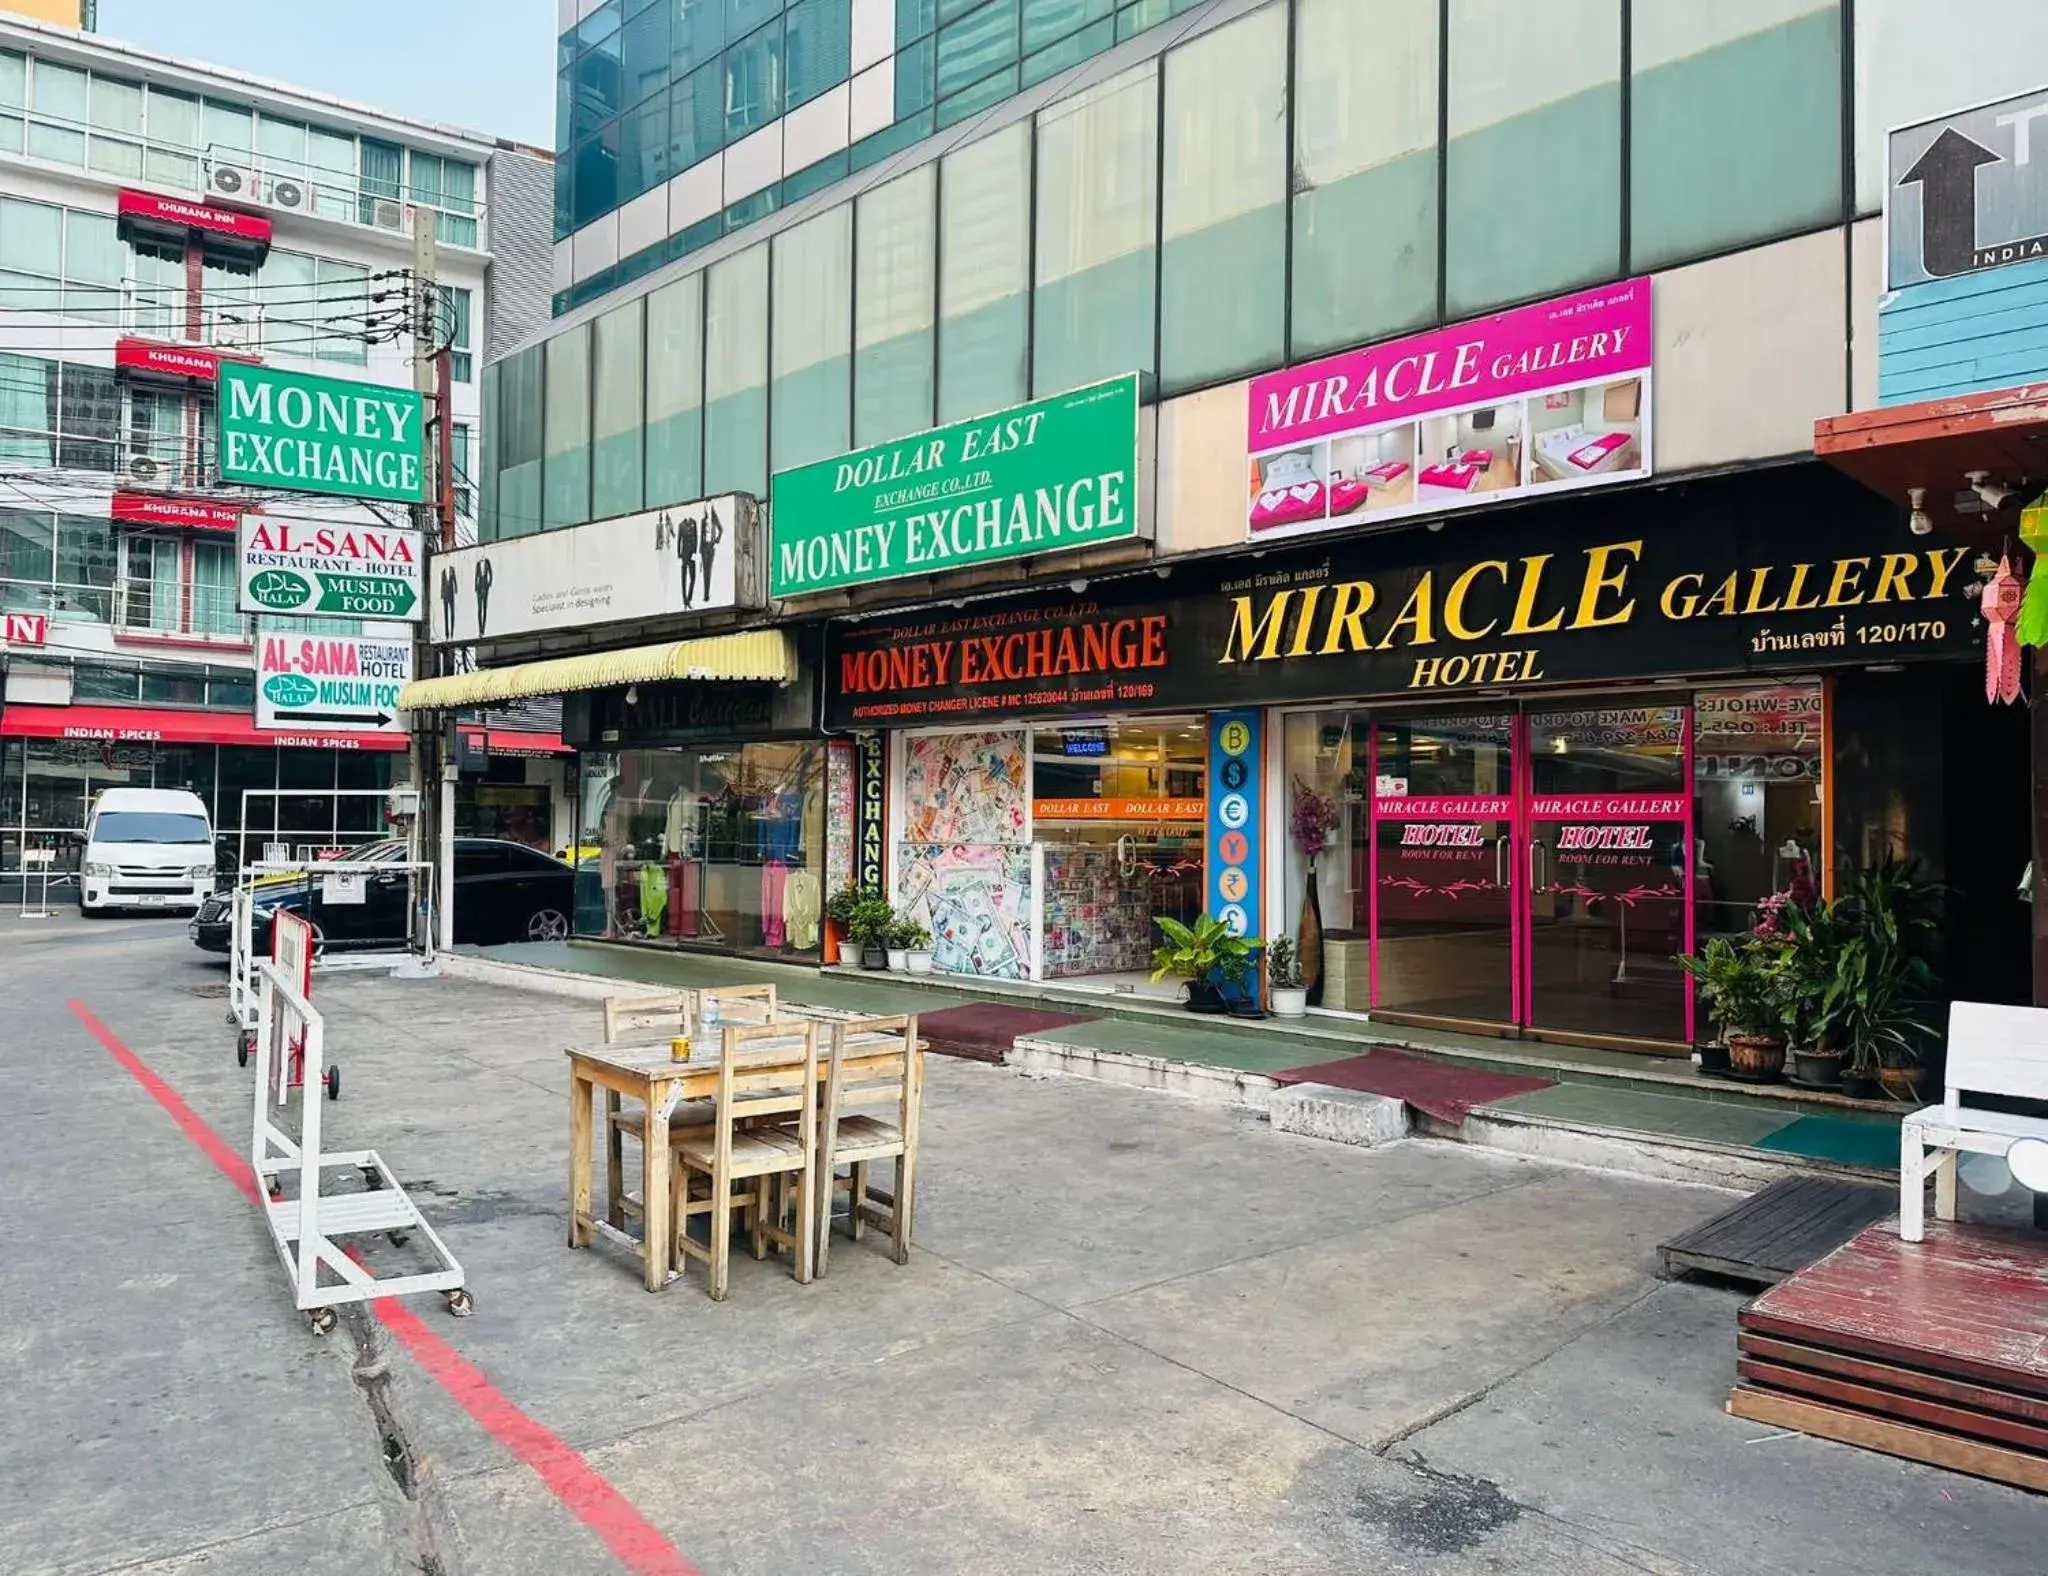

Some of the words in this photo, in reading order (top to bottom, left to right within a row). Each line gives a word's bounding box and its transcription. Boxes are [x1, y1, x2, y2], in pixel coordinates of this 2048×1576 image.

[157, 201, 212, 220] KHURANA
[214, 212, 235, 225] INN
[1973, 241, 2043, 266] INDIA
[148, 350, 213, 369] KHURANA
[1259, 340, 1486, 435] MIRACLE
[1490, 326, 1632, 380] GALLERY
[228, 377, 414, 443] MONEY
[226, 431, 419, 491] EXCHANGE
[833, 439, 946, 493] DOLLAR
[959, 411, 1046, 463] EAST
[874, 481, 940, 509] EXCHANGE
[143, 503, 208, 518] KHURANA
[213, 511, 236, 521] INN
[779, 520, 896, 586] MONEY
[905, 470, 1125, 564] EXCHANGE
[250, 523, 414, 563] AL-SANA
[246, 551, 352, 572] RESTAURANT
[366, 563, 417, 578] HOTEL
[257, 593, 303, 605] HALAL
[327, 578, 405, 597] MUSLIM
[341, 596, 396, 613] FOOD
[1218, 540, 1645, 664] MIRACLE
[1660, 547, 1969, 621] GALLERY
[10, 615, 41, 644] N
[892, 622, 936, 641] DOLLAR
[941, 616, 972, 634] EAST
[972, 608, 1042, 630] EXCHANGE
[1751, 614, 1846, 652] บ้านเลขที่
[1856, 620, 1946, 645] 120/170
[263, 638, 360, 677] AL-SANA
[359, 644, 409, 663] RESTAURANT
[839, 640, 953, 695] MONEY
[958, 614, 1168, 685] EXCHANGE
[360, 662, 406, 679] HOTEL
[1409, 649, 1544, 688] HOTEL
[320, 681, 372, 706] MUSLIM
[375, 685, 399, 708] FOO
[852, 703, 899, 719] AUTHORIZED
[900, 701, 928, 715] MONEY
[928, 698, 968, 713] CHANGER
[1117, 684, 1154, 699] 120/169
[63, 727, 114, 738] INDIAN
[119, 730, 161, 740] SPICES
[274, 736, 318, 748] INDIAN
[322, 739, 360, 749] SPICES
[1065, 742, 1106, 754] WELCOME
[1039, 803, 1080, 814] DOLLAR
[1084, 802, 1111, 814] EAST
[1125, 802, 1170, 814] DOLLAR
[1175, 801, 1205, 813] EAST
[1376, 800, 1438, 814] MIRACLE
[1442, 799, 1510, 814] GALLERY
[1531, 799, 1601, 814] MIRACLE
[1606, 799, 1685, 814] GALLERY
[1400, 824, 1485, 847] HOTEL
[1557, 825, 1654, 849] HOTEL
[1400, 849, 1430, 860] ROOM
[1431, 850, 1454, 861] FOR
[1455, 850, 1485, 861] RENT
[1558, 853, 1593, 865] ROOM
[1595, 854, 1619, 866] FOR
[1620, 855, 1654, 867] RENT
